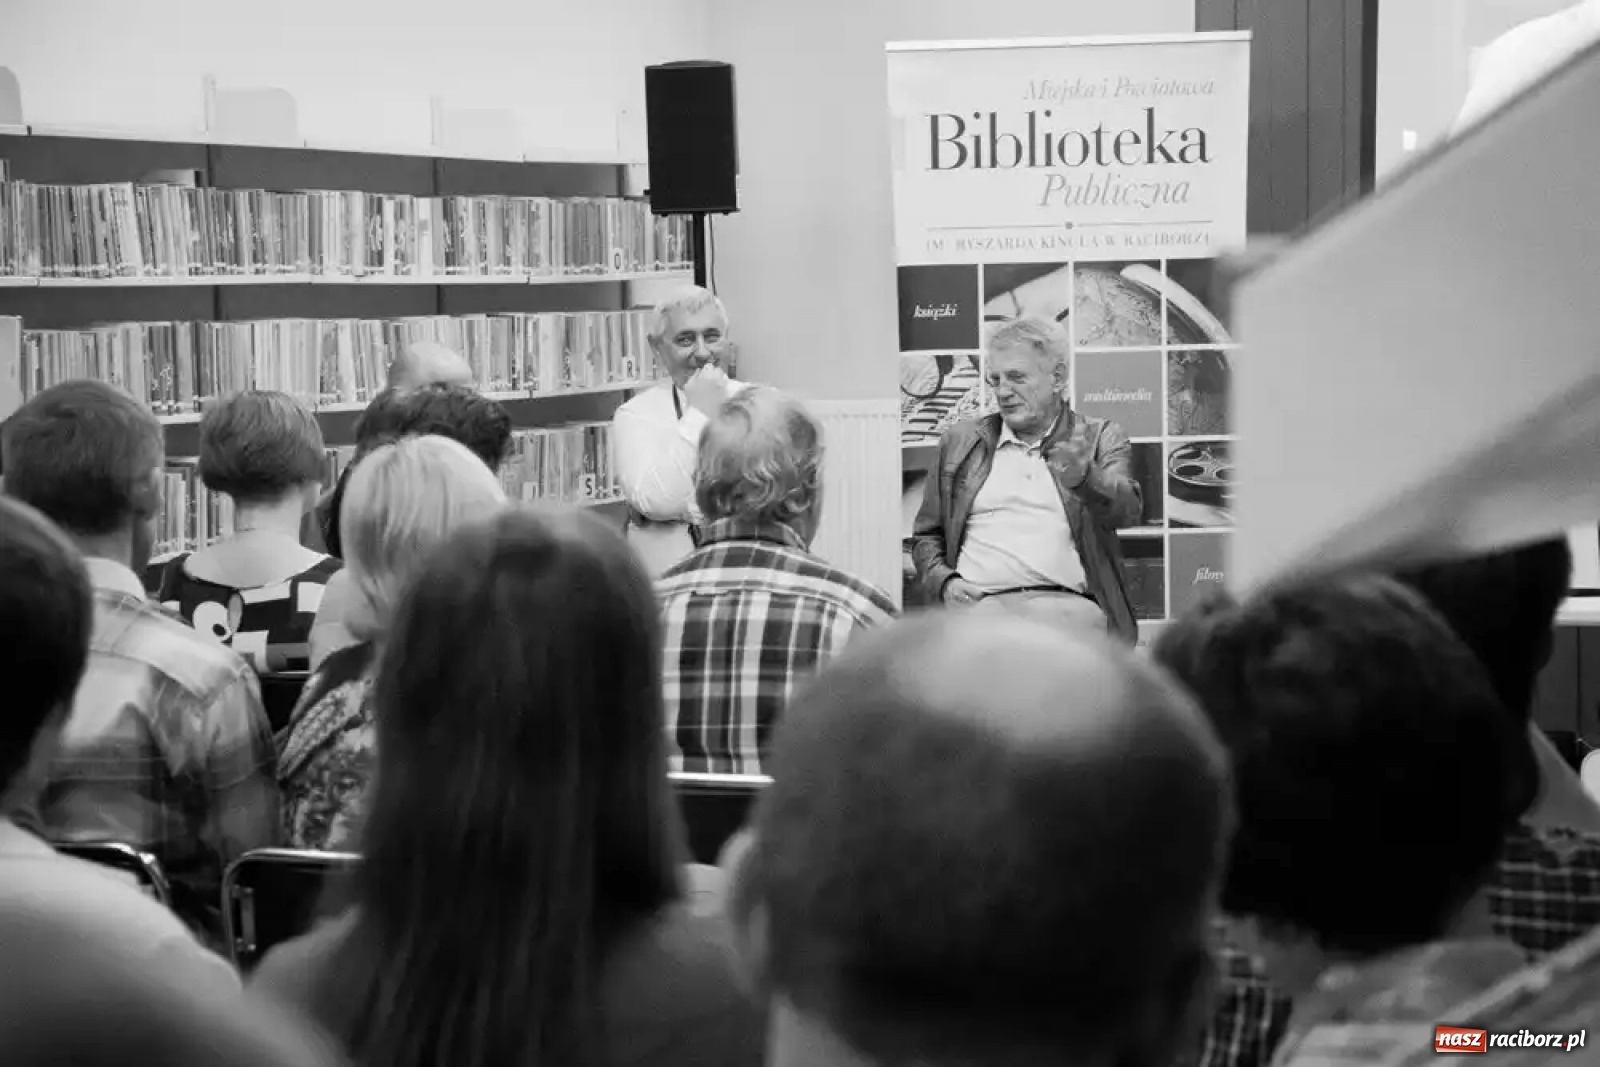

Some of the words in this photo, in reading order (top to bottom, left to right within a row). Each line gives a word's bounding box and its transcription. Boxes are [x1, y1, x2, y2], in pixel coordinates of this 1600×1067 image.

[925, 107, 1212, 170] Biblioteka
[1040, 172, 1190, 208] Publiczna
[913, 303, 958, 321] książki
[1083, 387, 1153, 402] multimedia
[585, 477, 592, 496] S
